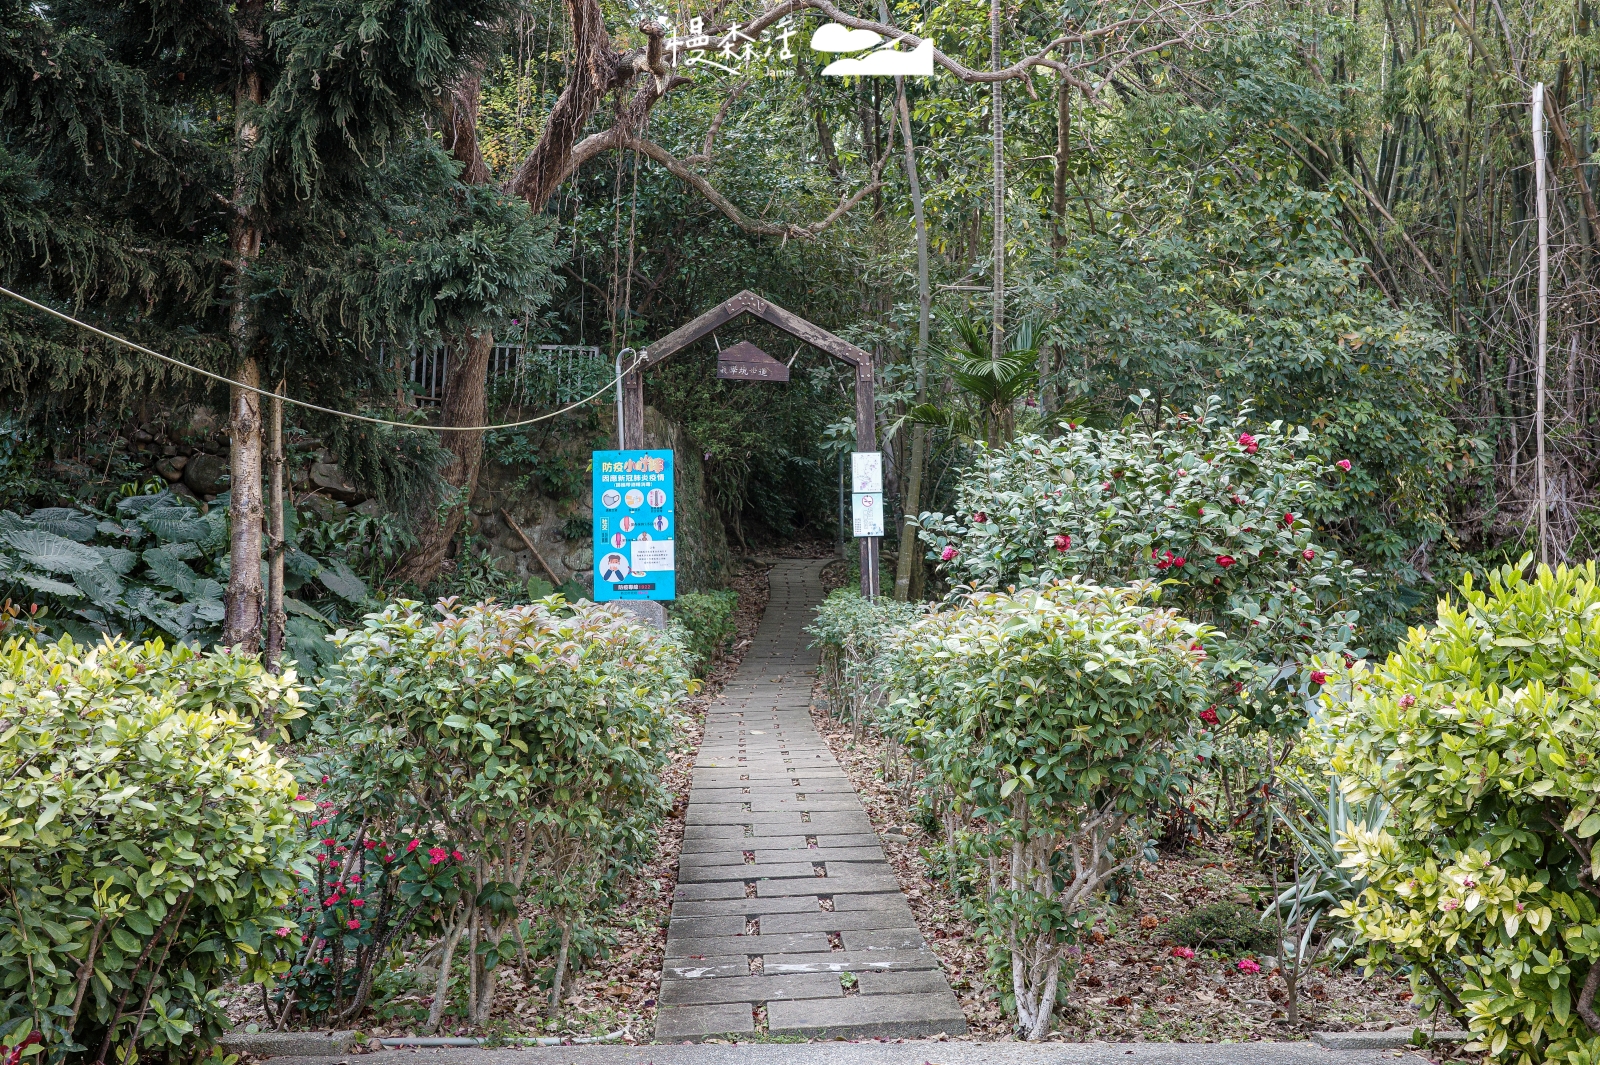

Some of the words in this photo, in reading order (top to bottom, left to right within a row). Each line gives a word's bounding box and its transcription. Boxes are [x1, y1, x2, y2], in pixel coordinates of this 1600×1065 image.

[602, 474, 665, 482] 因應新冠肺炎疫情
